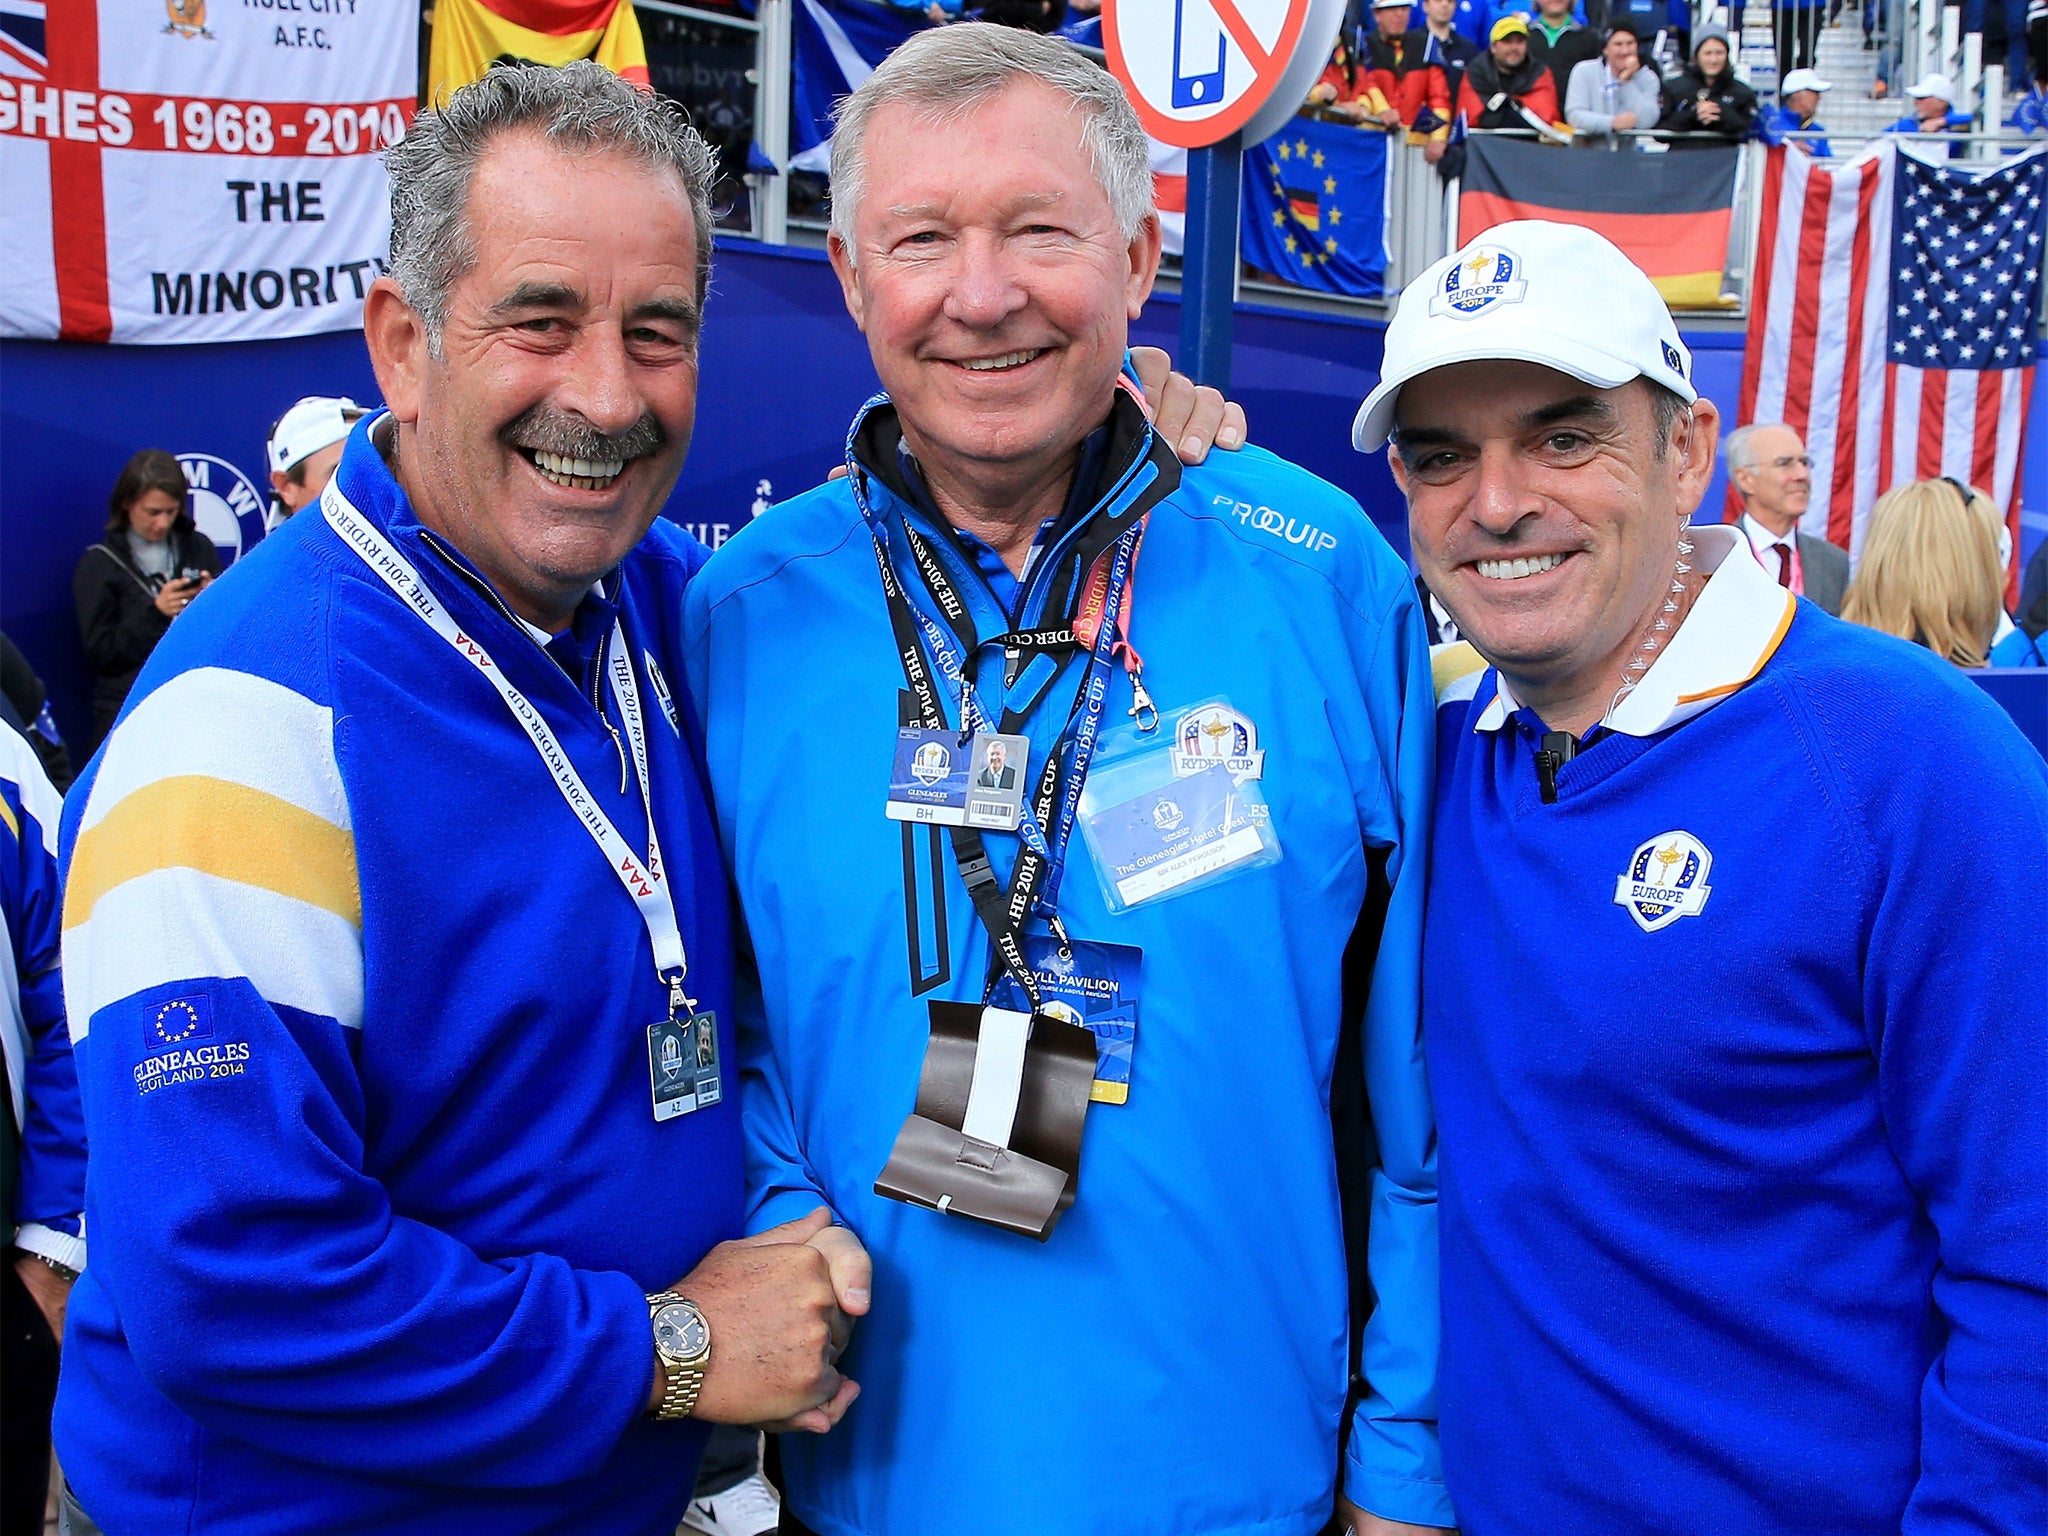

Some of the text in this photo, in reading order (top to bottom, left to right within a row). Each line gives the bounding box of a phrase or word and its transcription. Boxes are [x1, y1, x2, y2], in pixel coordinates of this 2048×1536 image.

[275, 26, 332, 50] A.F.C.
[227, 181, 325, 222] THE
[1448, 285, 1504, 304] EUROPE
[1460, 298, 1485, 309] 2014
[180, 459, 258, 518] MW
[336, 512, 382, 559] RYDER
[1212, 494, 1338, 552] PROQUIP
[1115, 525, 1138, 580] RYDER
[378, 555, 412, 588] 2014
[882, 567, 896, 598] CUP
[923, 558, 948, 591] 2014
[406, 583, 436, 619] THE
[938, 587, 963, 620] THE
[1084, 570, 1110, 617] RYDER
[1107, 581, 1121, 617] 2014
[456, 632, 493, 667] AAA
[1101, 619, 1115, 652] THE
[904, 646, 924, 682] THE
[914, 681, 936, 717] 2014
[938, 649, 961, 681] CUP
[1089, 676, 1106, 714] CUP
[612, 655, 631, 687] THE
[622, 690, 639, 721] 2014
[633, 726, 647, 777] RYDER
[1075, 715, 1098, 773] RYDER
[507, 689, 608, 841] THE 2014 RYDER CUP
[1043, 758, 1057, 796] CUP
[1226, 759, 1254, 770] CUP
[1066, 774, 1082, 812] 2014
[915, 807, 934, 820] BH
[1036, 791, 1052, 834] DER
[1021, 823, 1045, 856] CUP
[1060, 814, 1073, 848] THE
[1116, 860, 1136, 876] The
[1136, 839, 1190, 869] Gleneagles
[1190, 827, 1217, 846] Hotel
[1217, 815, 1247, 834] Gest
[621, 856, 653, 897] AAA
[1017, 854, 1039, 894] 2014
[1630, 885, 1685, 904] EUROPE
[1640, 902, 1664, 914] 2014
[999, 932, 1024, 968] THE
[1017, 967, 1041, 1001] 2014
[1003, 969, 1056, 984] AYLL
[1059, 974, 1119, 993] PAVILION
[1064, 988, 1085, 996] ARGYLL
[1085, 990, 1111, 999] PAVILION
[1097, 1015, 1127, 1039] UP
[134, 1042, 250, 1083] GLENEAGLES
[208, 1062, 244, 1079] 2014
[671, 1101, 681, 1114] AZ
